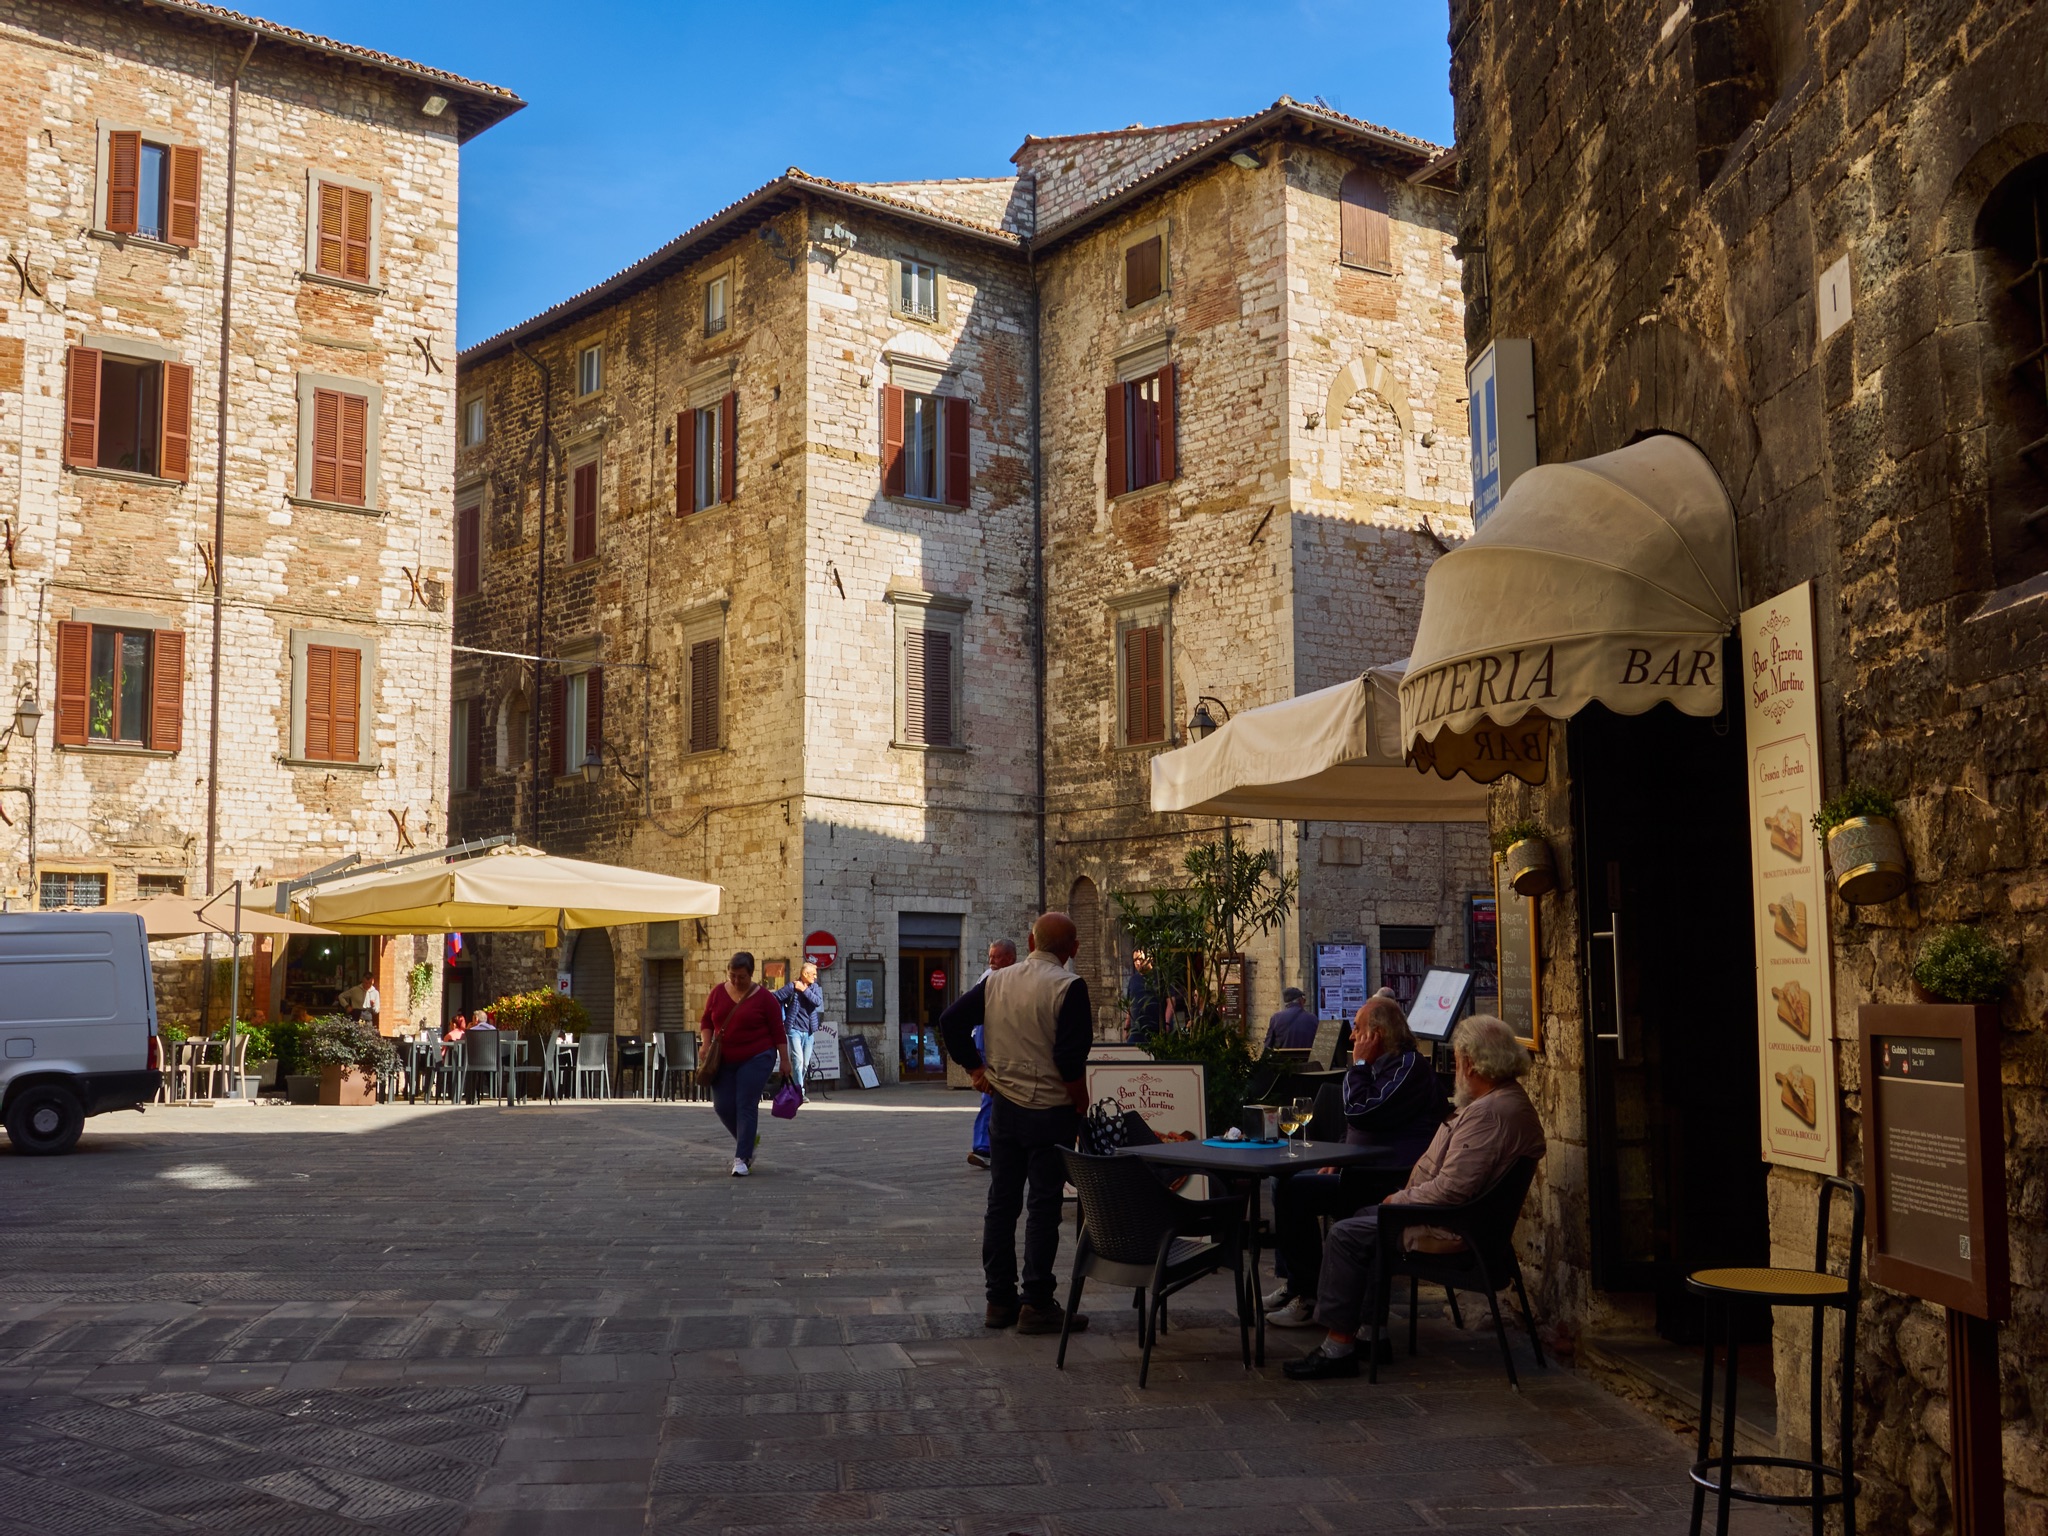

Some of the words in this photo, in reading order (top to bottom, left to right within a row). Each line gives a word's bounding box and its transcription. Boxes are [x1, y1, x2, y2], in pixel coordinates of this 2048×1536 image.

[1470, 348, 1494, 480] T
[1752, 648, 1769, 679] Bar
[1770, 633, 1803, 666] Pizzeria
[1401, 644, 1557, 736] PIZZERIA
[1619, 648, 1717, 687] BAR
[1752, 681, 1769, 709] San
[1770, 665, 1805, 696] Martino
[1759, 762, 1780, 783] Crescia
[1781, 753, 1804, 778] Farcita
[561, 981, 569, 990] P
[1891, 1045, 1908, 1055] Gubbio
[1117, 1085, 1137, 1099] Bar
[1140, 1083, 1175, 1099] Pizzeria
[1117, 1098, 1136, 1111] San
[1139, 1096, 1175, 1111] Martino
